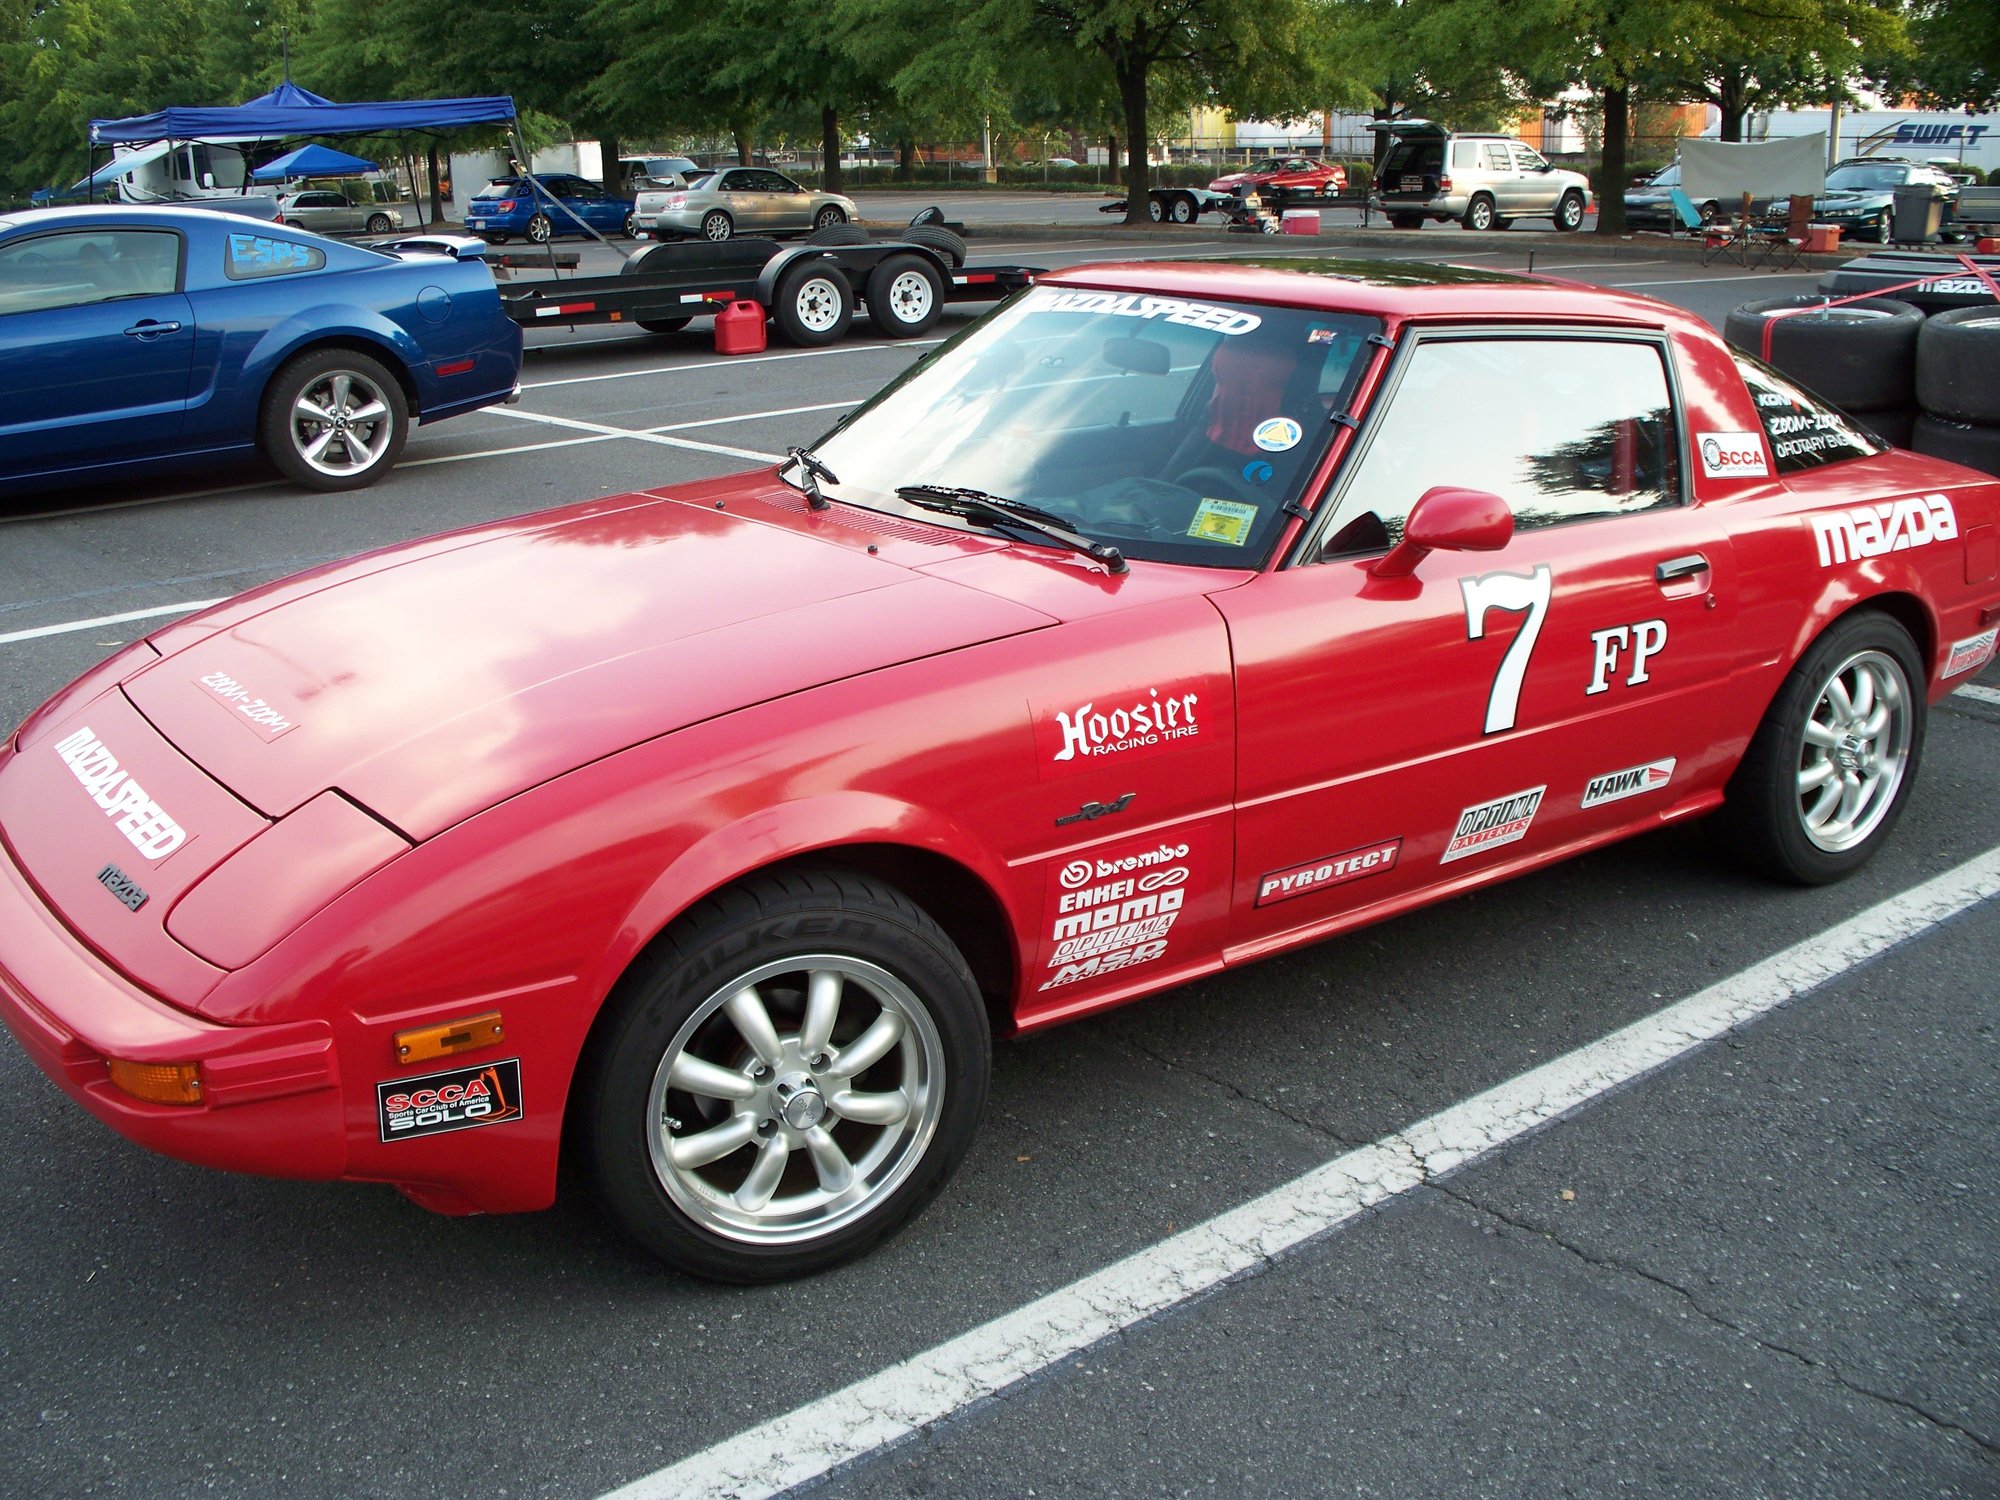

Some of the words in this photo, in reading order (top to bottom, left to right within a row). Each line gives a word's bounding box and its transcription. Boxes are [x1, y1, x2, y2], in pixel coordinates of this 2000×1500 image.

[1893, 124, 1990, 145] SWIFT
[229, 233, 310, 267] ESPS
[1031, 294, 1262, 336] AZDASPEED
[1719, 450, 1764, 466] SCCA
[1458, 562, 1552, 737] 7
[1585, 618, 1669, 696] FP
[200, 671, 291, 733] ZOOM-ZOOM
[1053, 687, 1198, 761] Hoosier
[1093, 733, 1159, 757] RACING
[1162, 724, 1199, 741] TIRE
[54, 726, 187, 860] MAZDASPEED
[1585, 767, 1648, 801] HAWK
[1457, 792, 1542, 837] OPTIMA
[1451, 819, 1528, 851] BATTERIES
[1097, 844, 1190, 878] brembo
[1261, 846, 1397, 897] PYROTECT
[1059, 878, 1135, 914] ENKEI
[1054, 912, 1177, 958] OPTIMA
[1048, 953, 1157, 988] IGNITION
[1049, 939, 1168, 982] MSD
[385, 1079, 491, 1113] SCCA
[388, 1109, 414, 1120] Sports
[429, 1104, 448, 1112] Club
[449, 1101, 457, 1109] of
[459, 1096, 490, 1107] America
[389, 1102, 492, 1132] SOLO
